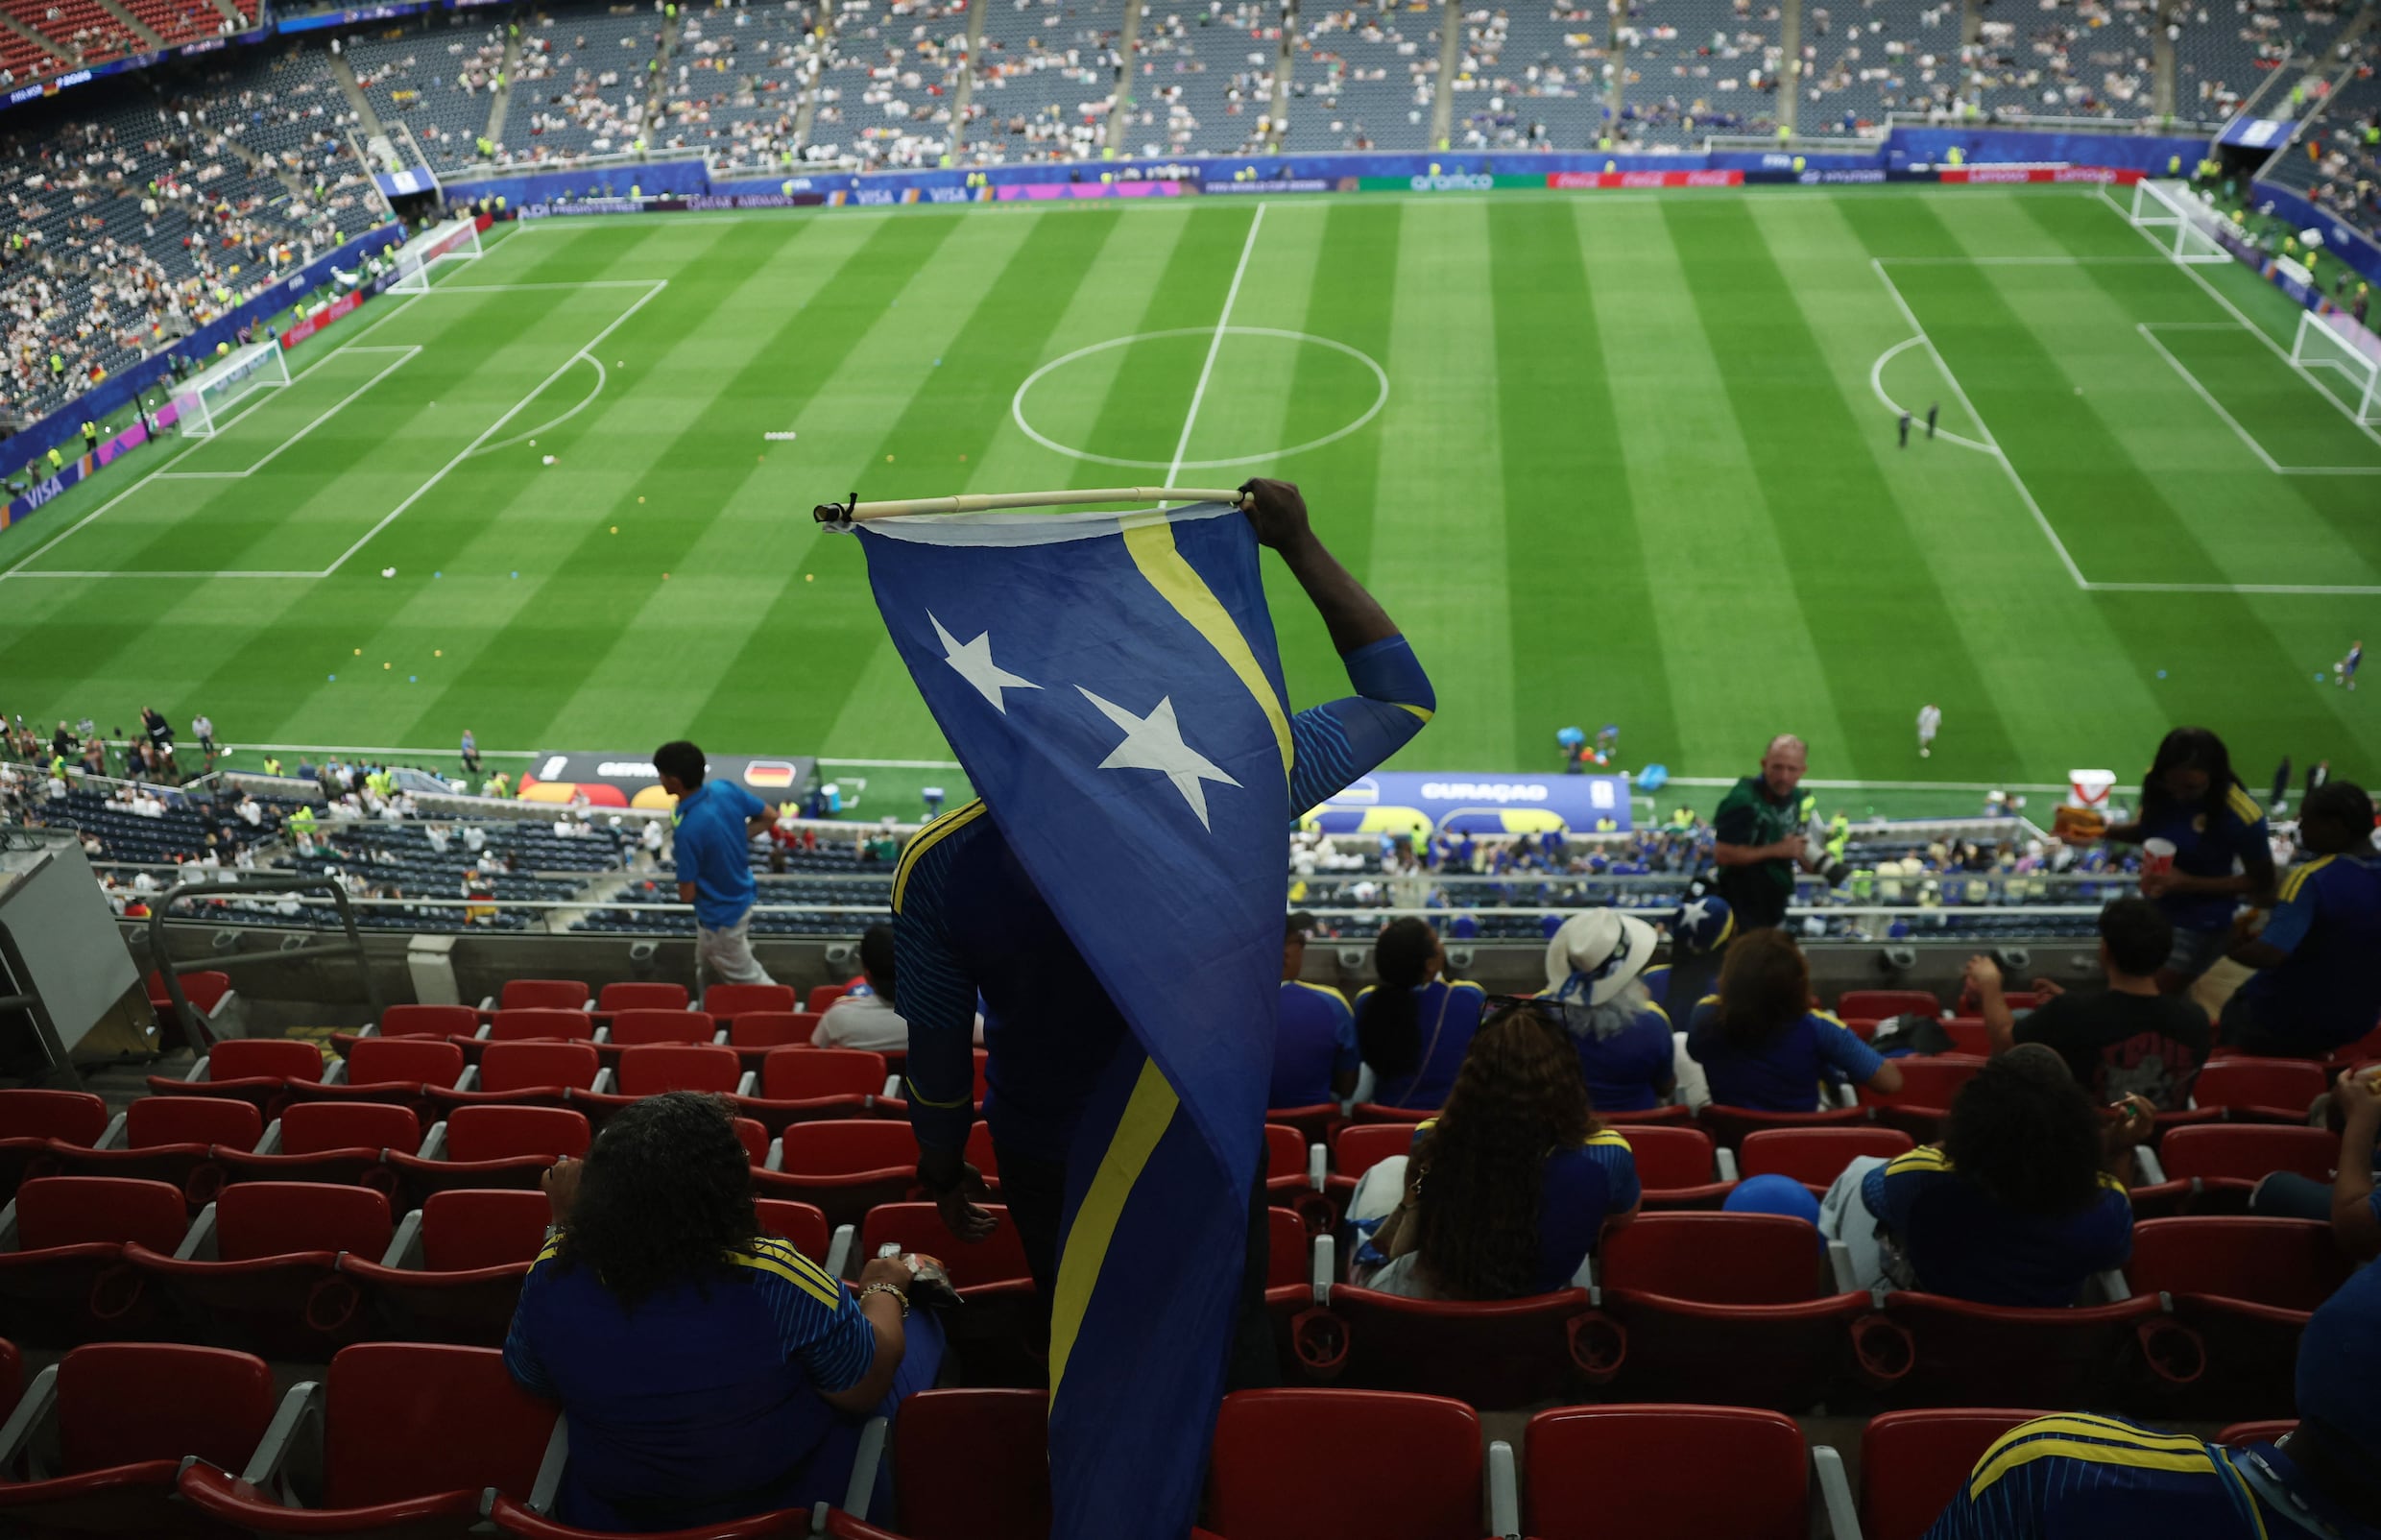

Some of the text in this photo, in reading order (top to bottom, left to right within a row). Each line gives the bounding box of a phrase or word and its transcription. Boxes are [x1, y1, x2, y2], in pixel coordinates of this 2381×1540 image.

[1410, 174, 1494, 191] aramco
[686, 194, 795, 211] QATAR AIRWAYS
[855, 187, 970, 205] VISA VISA
[24, 474, 63, 511] VISA
[1421, 782, 1549, 804] CURAÇAO
